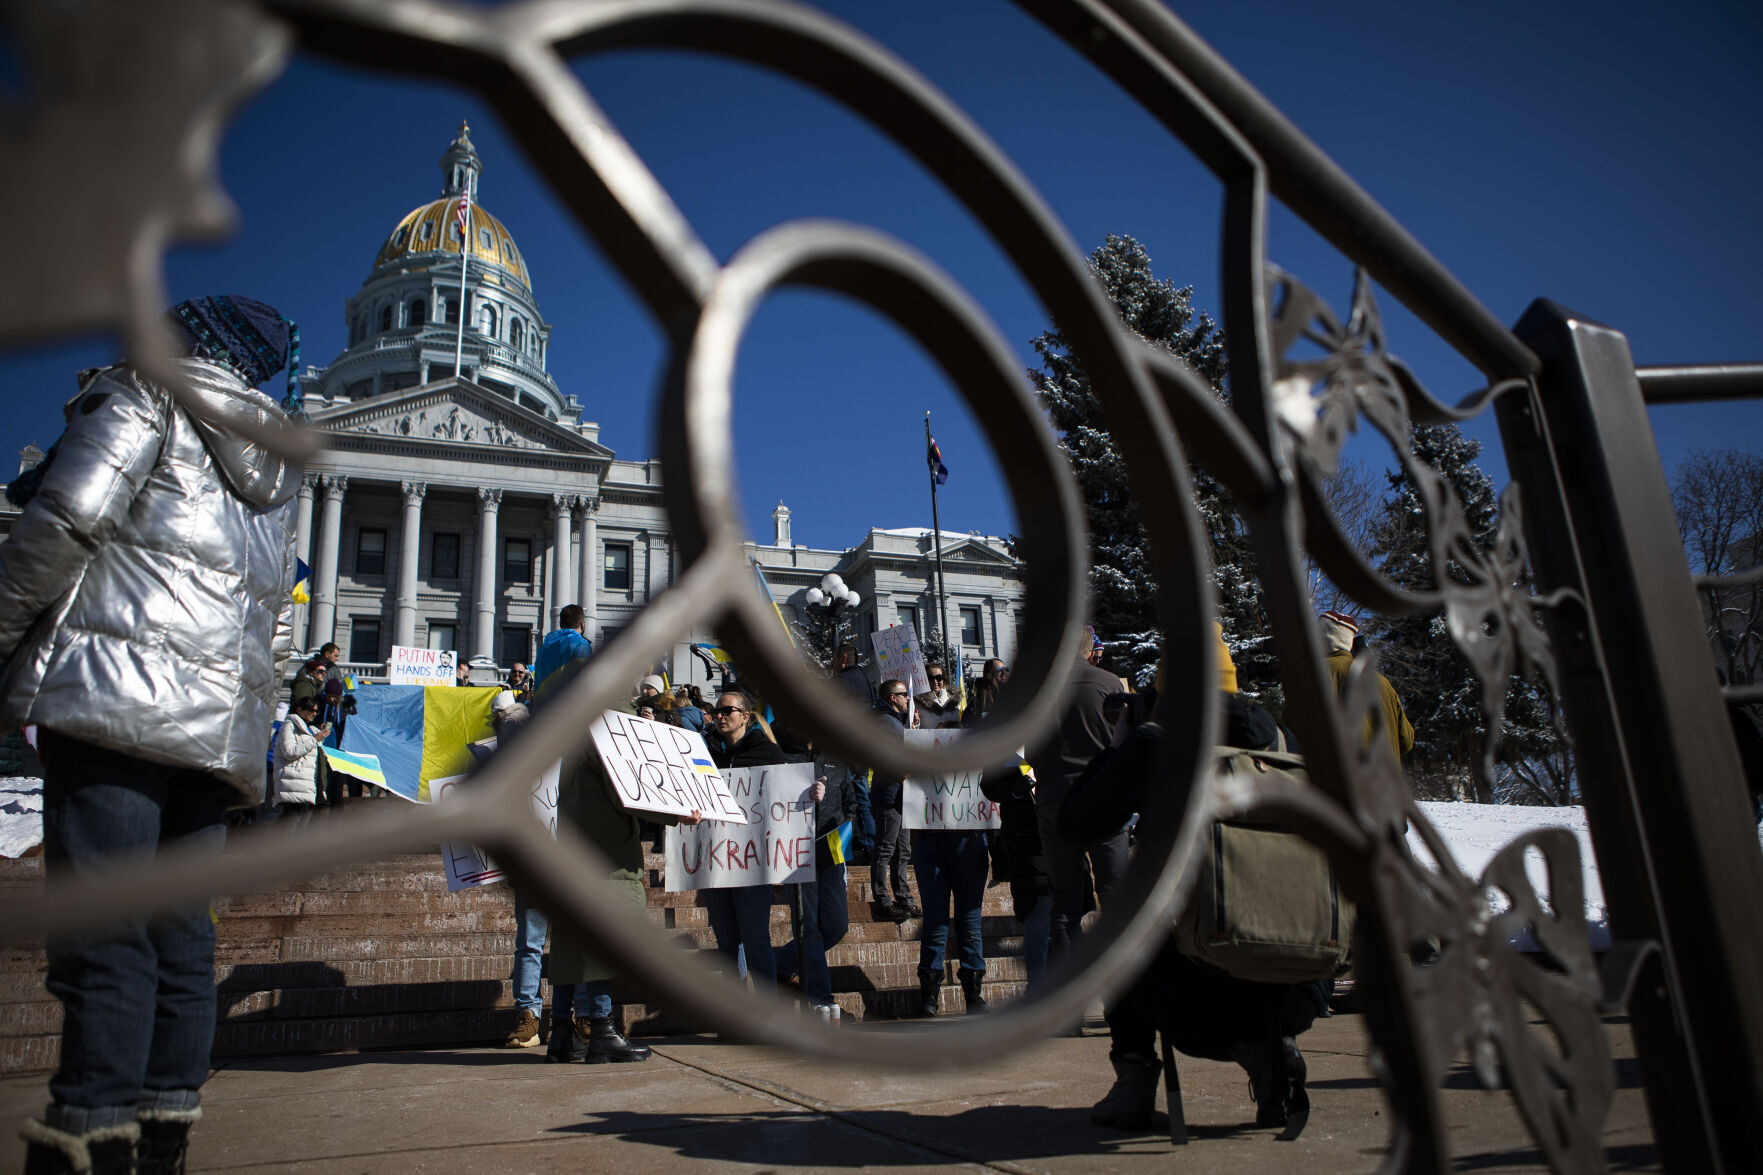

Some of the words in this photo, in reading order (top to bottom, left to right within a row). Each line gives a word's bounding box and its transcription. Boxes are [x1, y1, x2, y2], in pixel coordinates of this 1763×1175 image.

[874, 624, 916, 650] PEACE
[399, 648, 435, 663] PUTIN
[396, 664, 431, 676] HANDS
[435, 668, 454, 678] OFF
[406, 676, 453, 687] UKRAINE
[602, 711, 692, 770] HELP
[606, 754, 741, 816] UKRAINE
[770, 801, 815, 825] OFF
[952, 800, 1001, 823] UKRA
